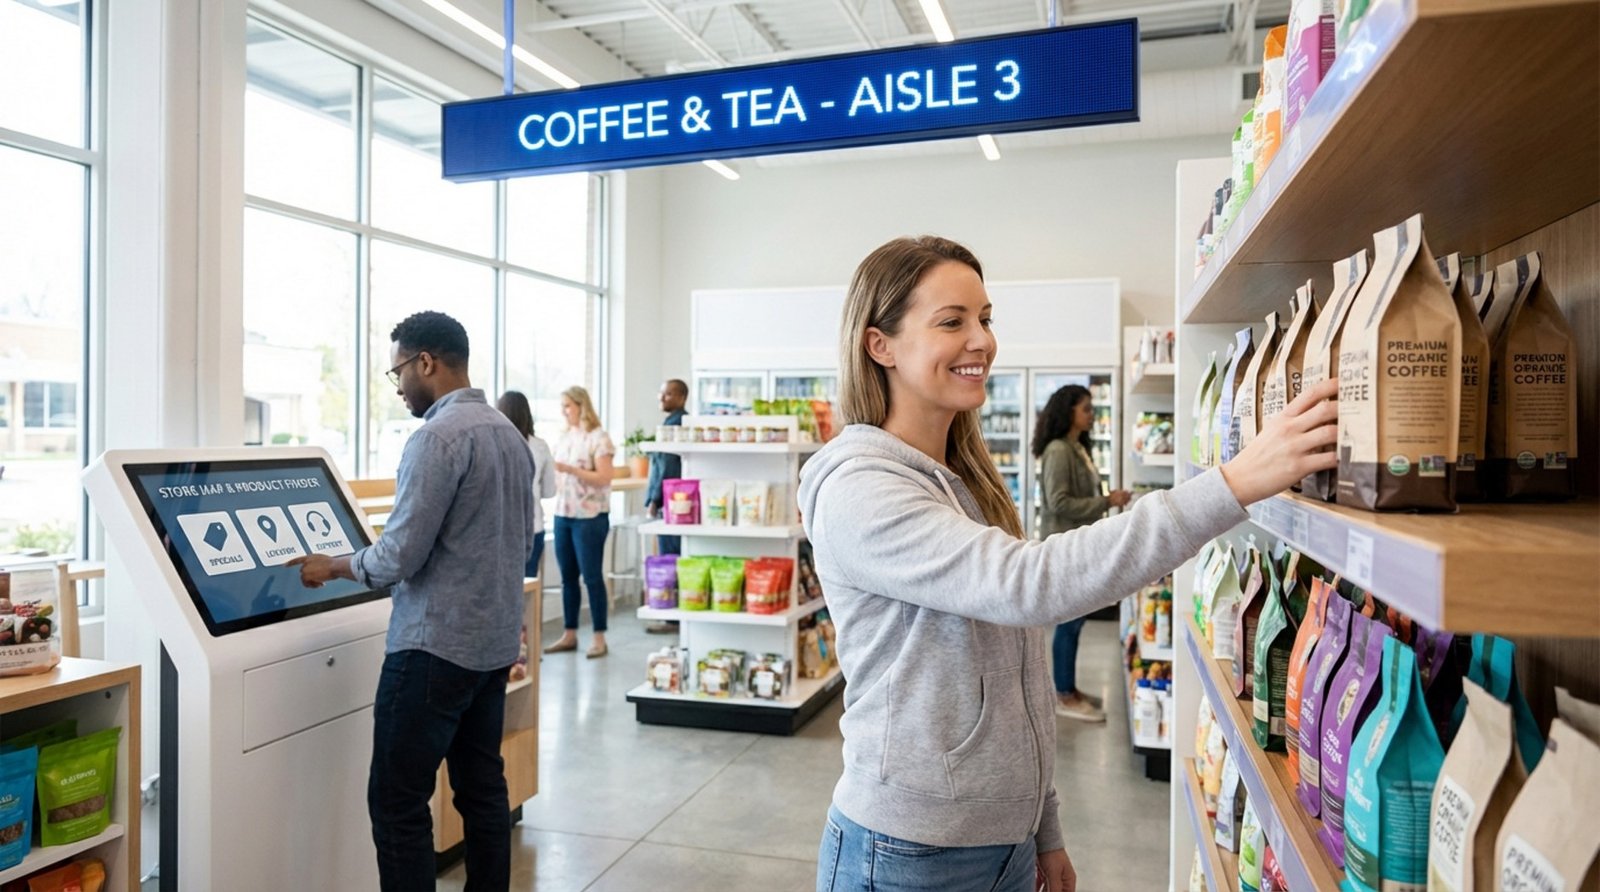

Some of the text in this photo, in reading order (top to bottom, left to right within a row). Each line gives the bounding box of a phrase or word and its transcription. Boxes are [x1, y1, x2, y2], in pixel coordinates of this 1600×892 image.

[518, 99, 669, 150] COFFEE
[680, 95, 712, 133] &
[722, 85, 807, 129] TEA
[848, 64, 979, 117] AISLE
[993, 59, 1021, 101] 3
[1387, 341, 1448, 351] PREMIUM
[1387, 365, 1448, 377] COFFEE
[1514, 374, 1566, 384] COFFEE
